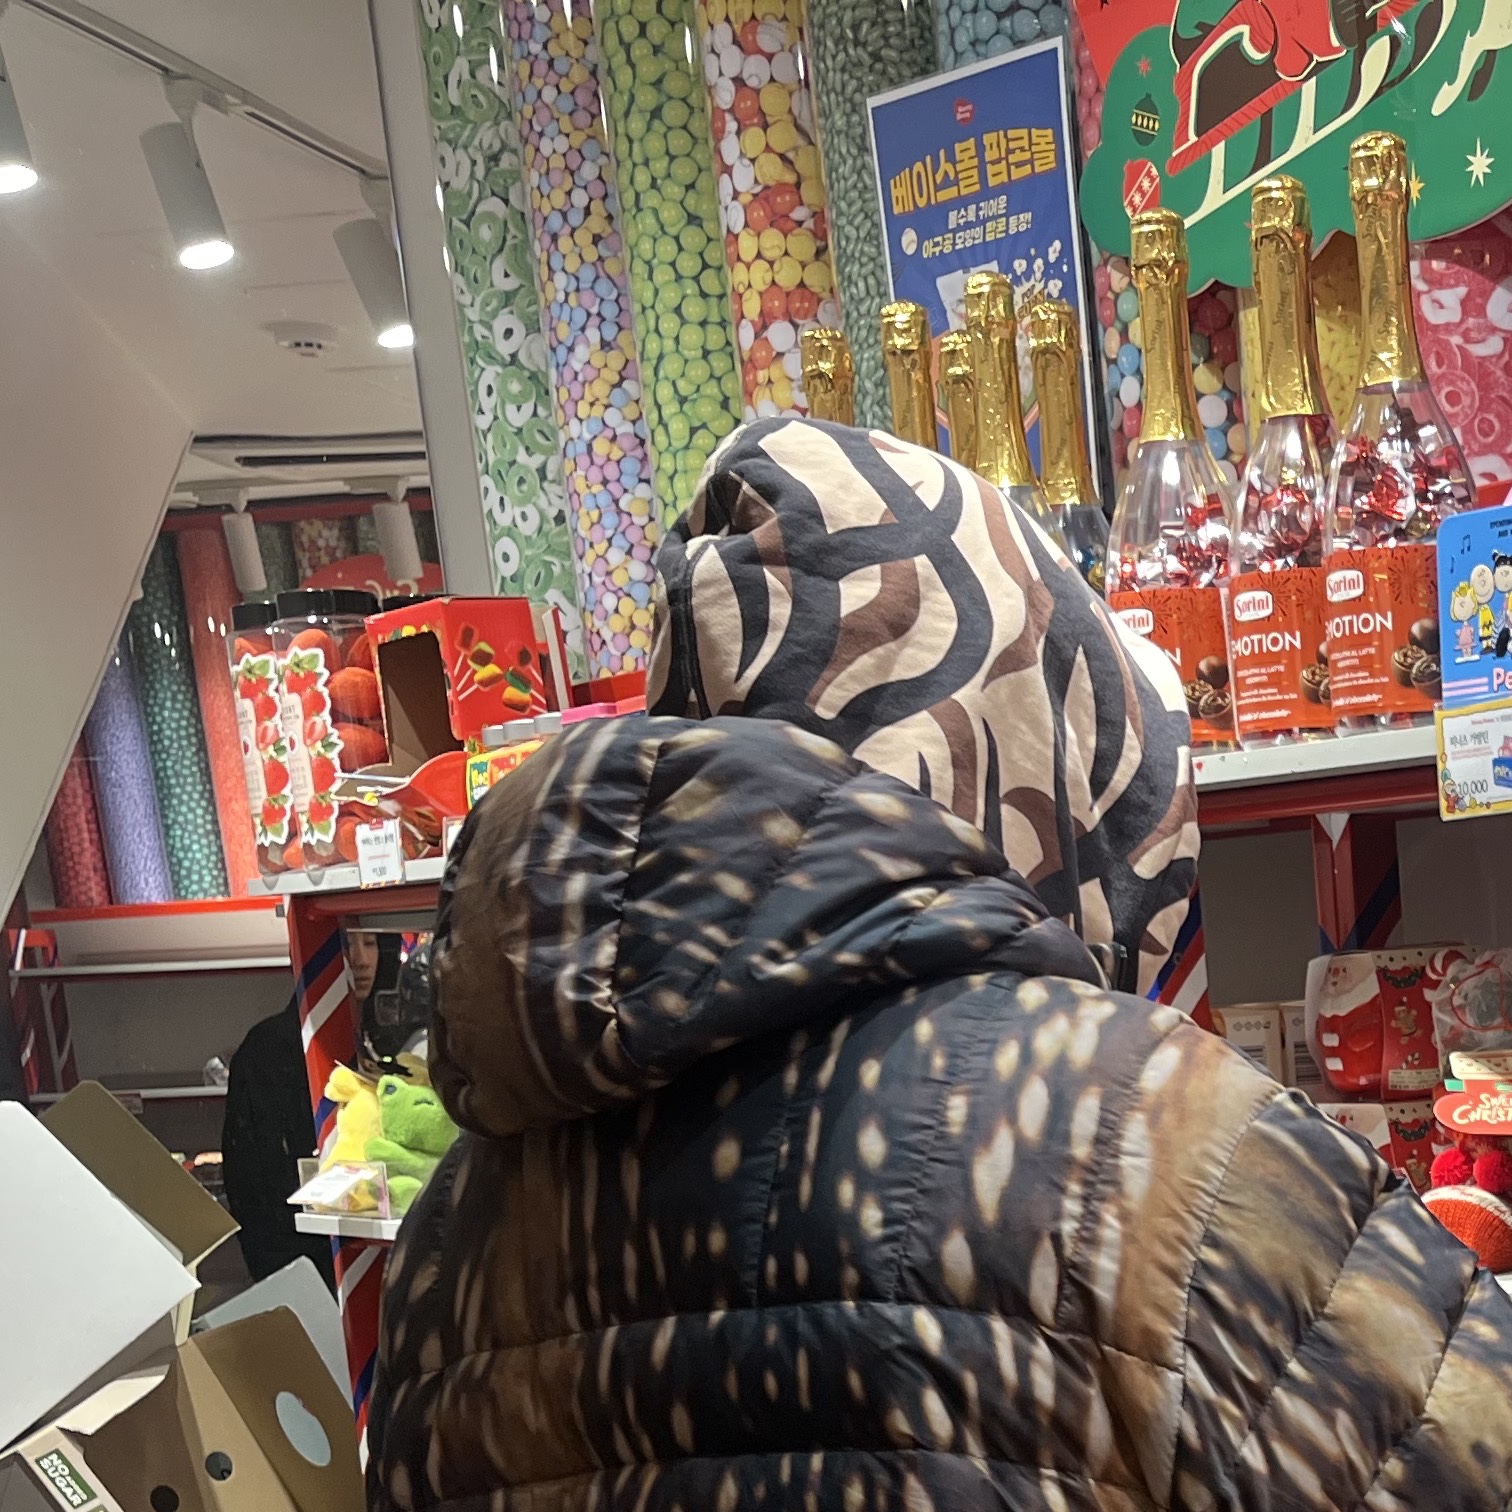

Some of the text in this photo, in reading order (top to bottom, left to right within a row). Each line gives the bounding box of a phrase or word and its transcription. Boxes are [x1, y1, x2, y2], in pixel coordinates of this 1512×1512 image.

[922, 232, 953, 258] 야구공
[954, 226, 983, 250] 모양의
[48, 1452, 70, 1476] NO
[39, 1458, 83, 1508] SUGAR
